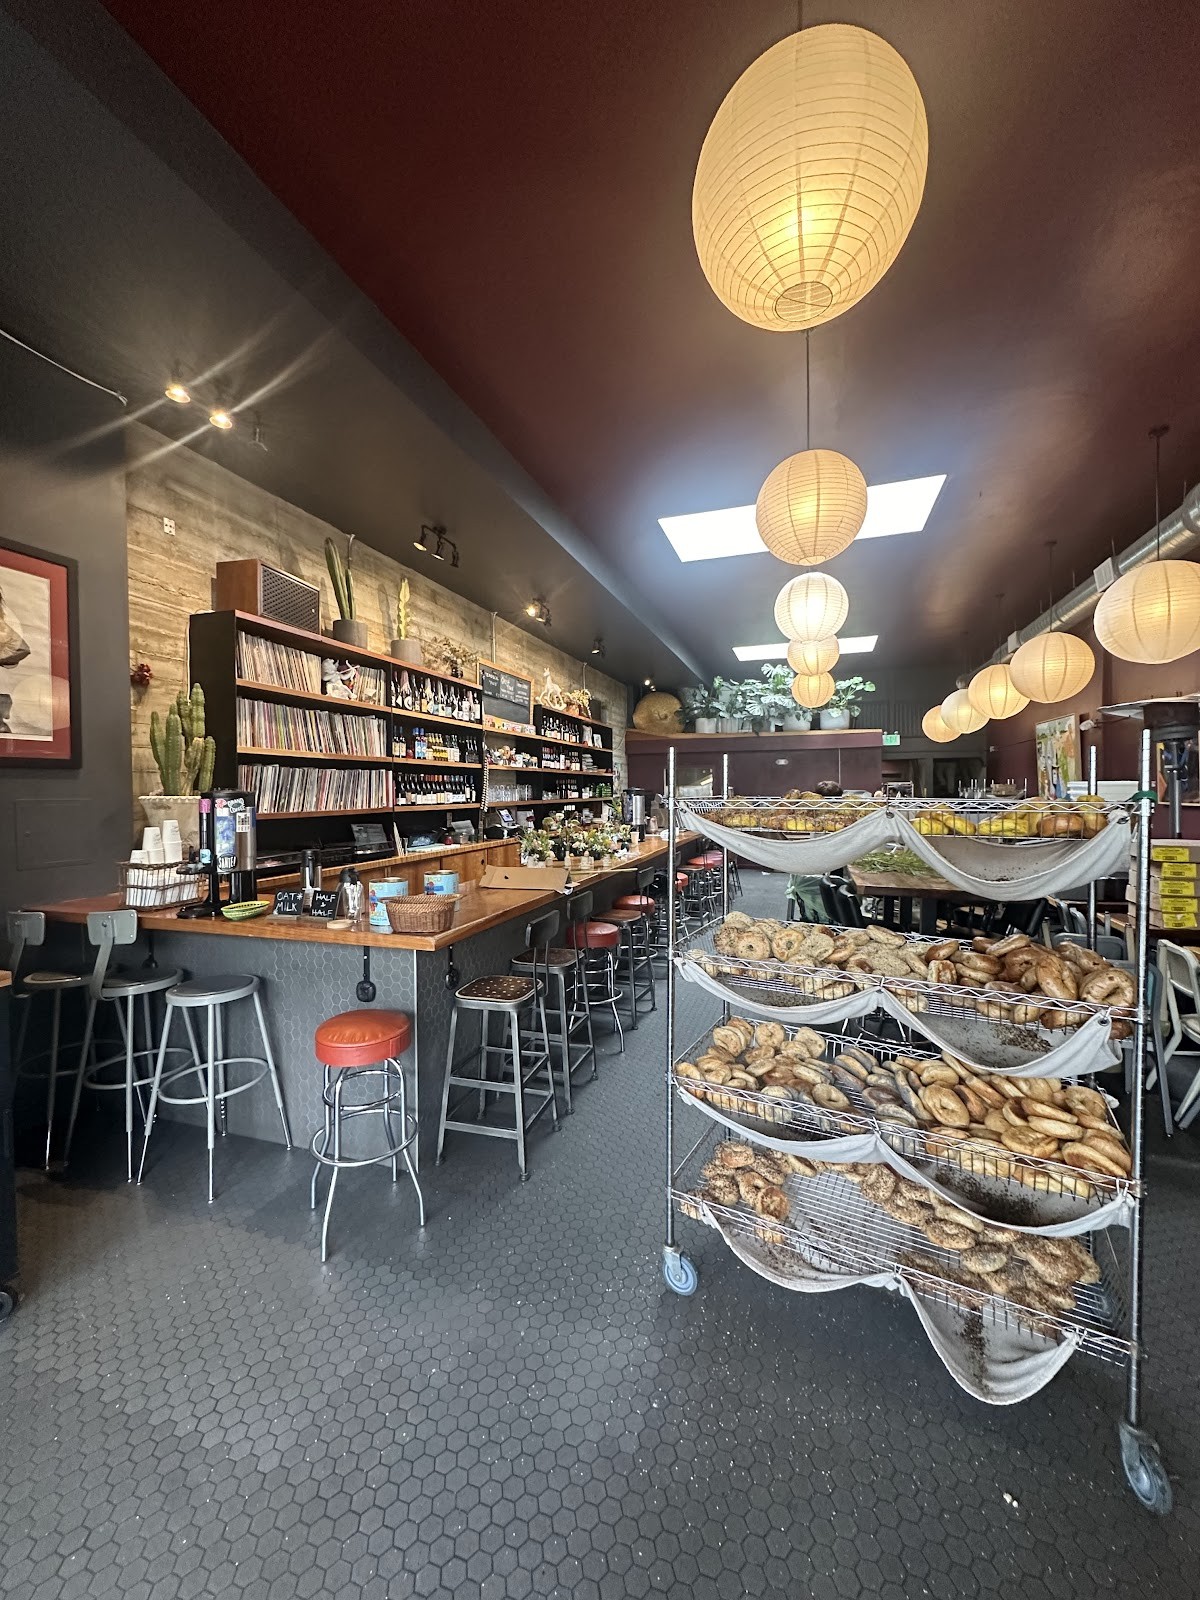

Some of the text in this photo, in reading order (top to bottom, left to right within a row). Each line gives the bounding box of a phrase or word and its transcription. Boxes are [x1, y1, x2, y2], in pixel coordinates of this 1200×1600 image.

[315, 892, 336, 902] HALF
[275, 901, 298, 912] MILK
[311, 909, 333, 917] HALF
